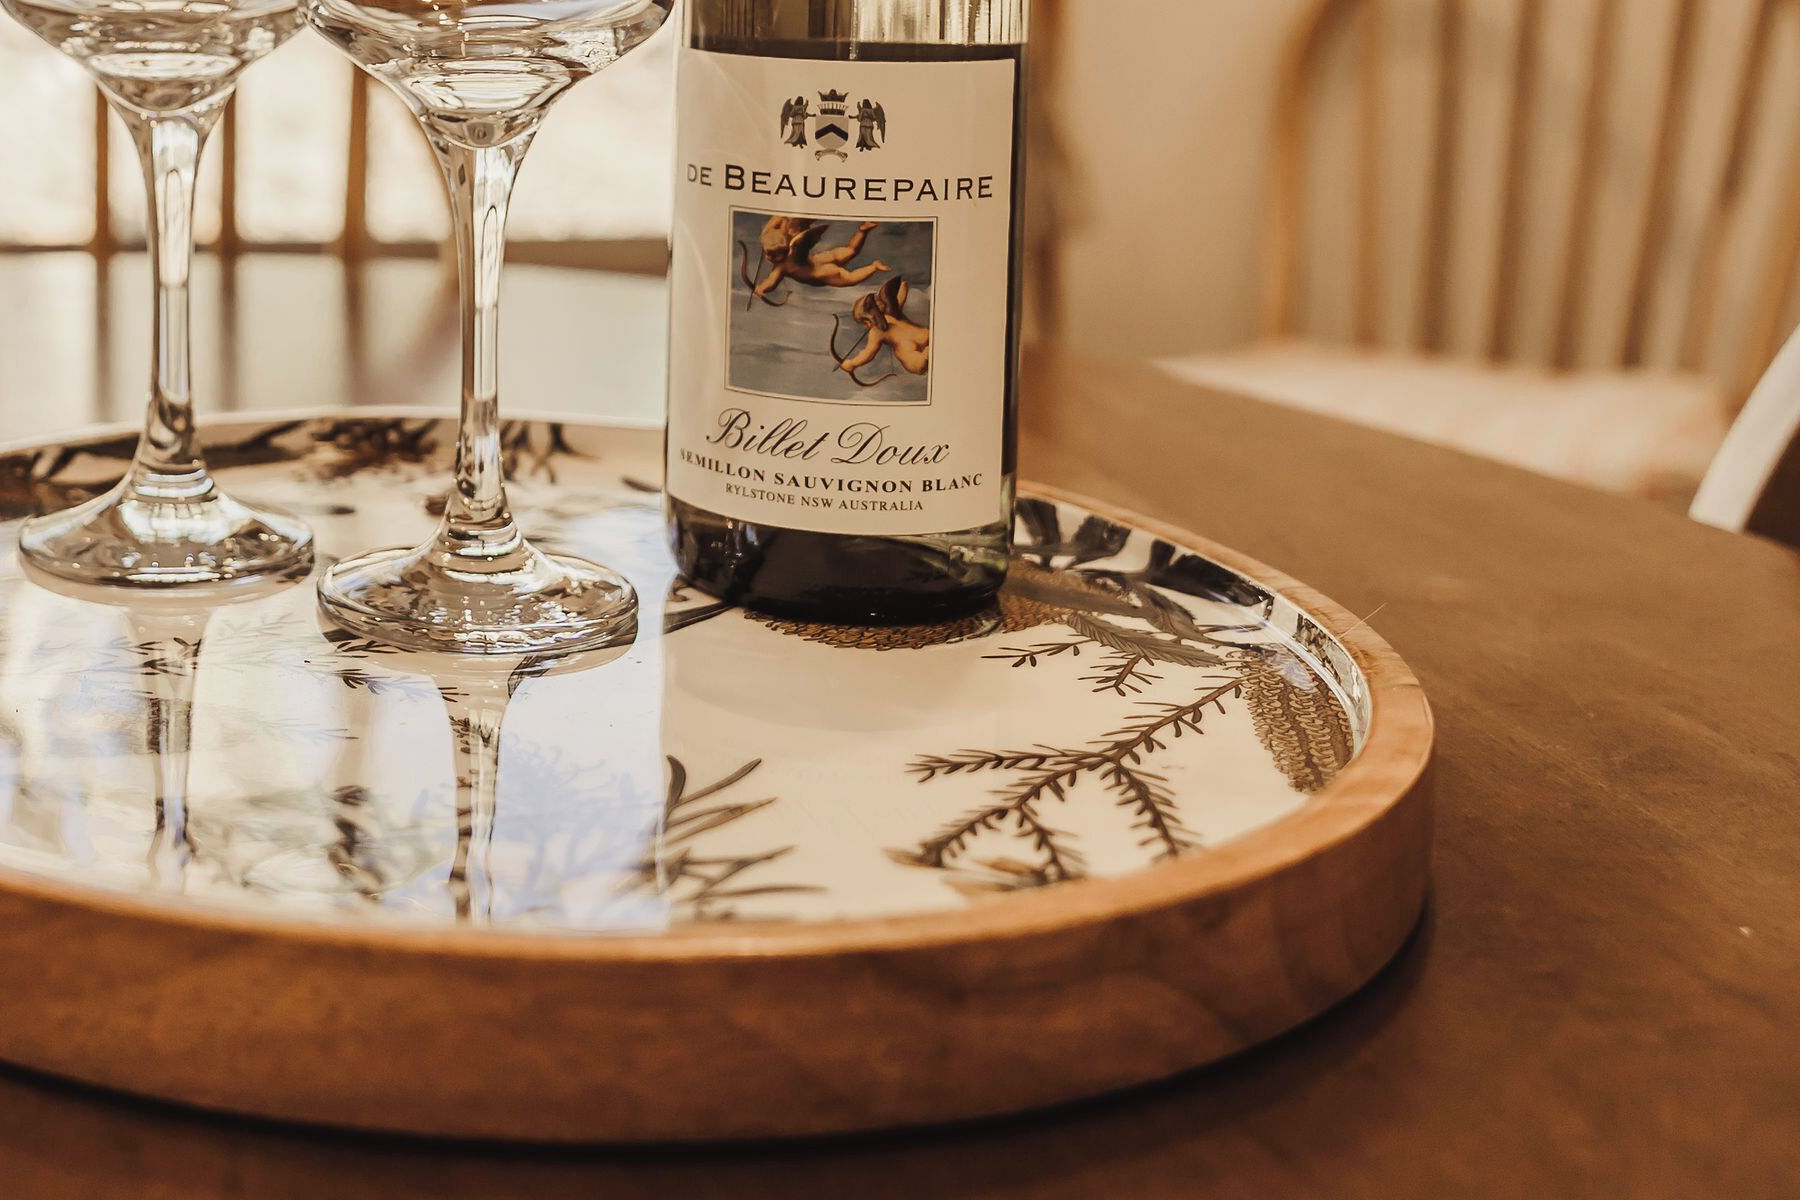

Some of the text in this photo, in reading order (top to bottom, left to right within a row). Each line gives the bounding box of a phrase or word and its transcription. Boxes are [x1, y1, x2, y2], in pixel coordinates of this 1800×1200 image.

[686, 163, 993, 201] DE BEAUREPAIRE
[705, 407, 950, 465] Billet Doux
[725, 482, 924, 512] RYLSTONE NSW AUSTRALIA
[774, 471, 912, 494] SAUVIGNON
[921, 472, 983, 493] BLANC
